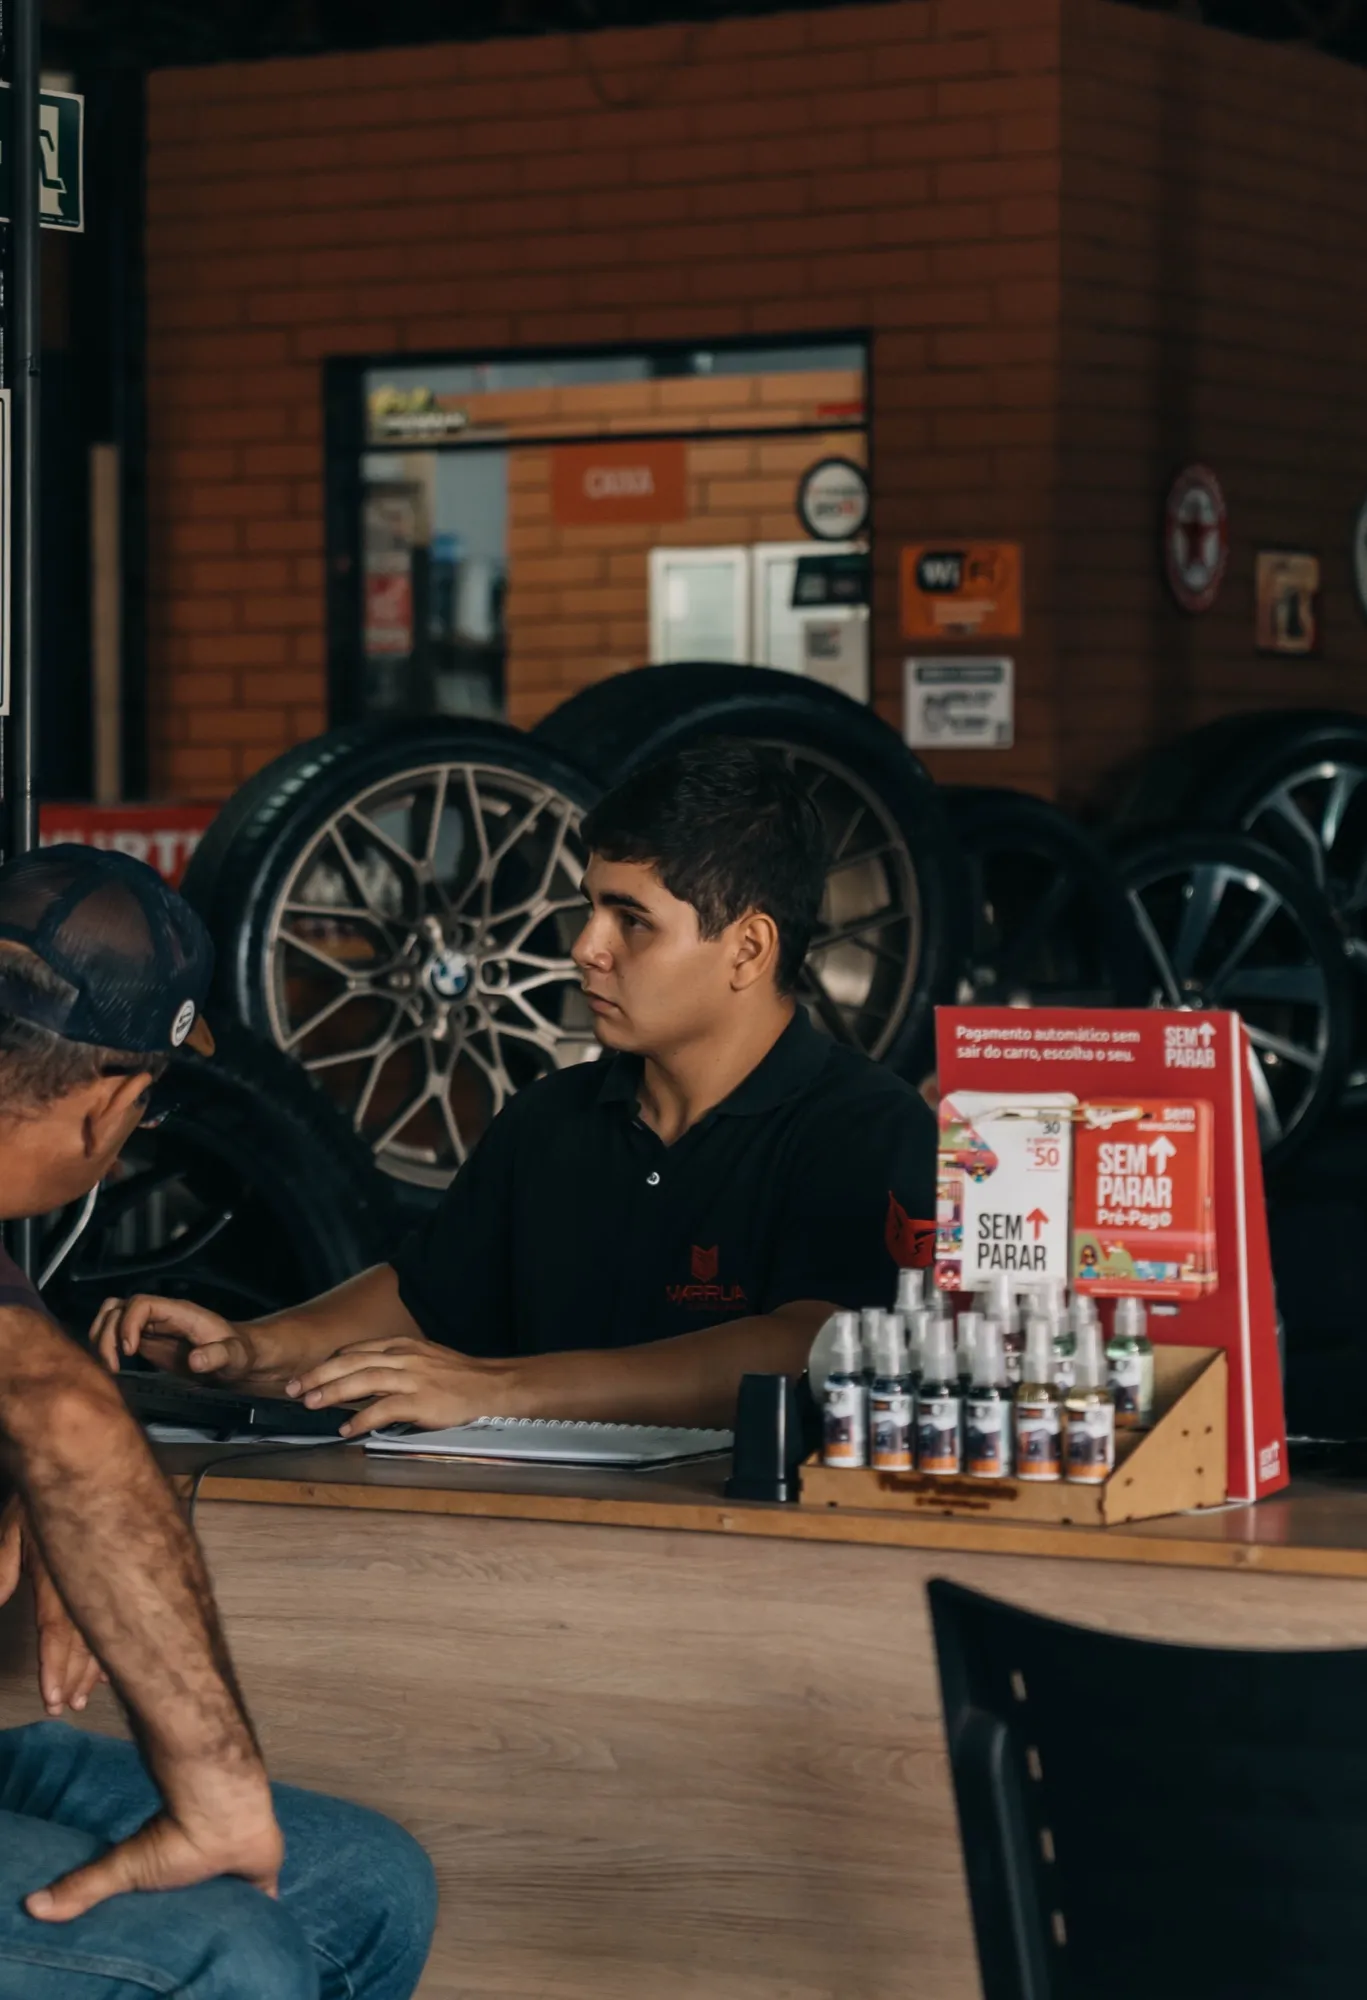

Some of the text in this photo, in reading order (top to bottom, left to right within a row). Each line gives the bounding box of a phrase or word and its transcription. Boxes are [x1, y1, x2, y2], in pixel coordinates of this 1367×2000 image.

[956, 1025, 1141, 1042] Pagamento automático sem
[1164, 1026, 1198, 1046] SEM
[957, 1044, 1135, 1062] sair do carro, escolha o seu.
[1165, 1047, 1216, 1068] PARAR
[1042, 1121, 1061, 1135] 30
[1034, 1147, 1060, 1168] 50
[1097, 1143, 1148, 1175] SEM
[1097, 1175, 1172, 1208] PARAR
[978, 1213, 1022, 1240] SEM
[1097, 1207, 1172, 1230] Pré-Pago
[978, 1243, 1046, 1271] PARAR
